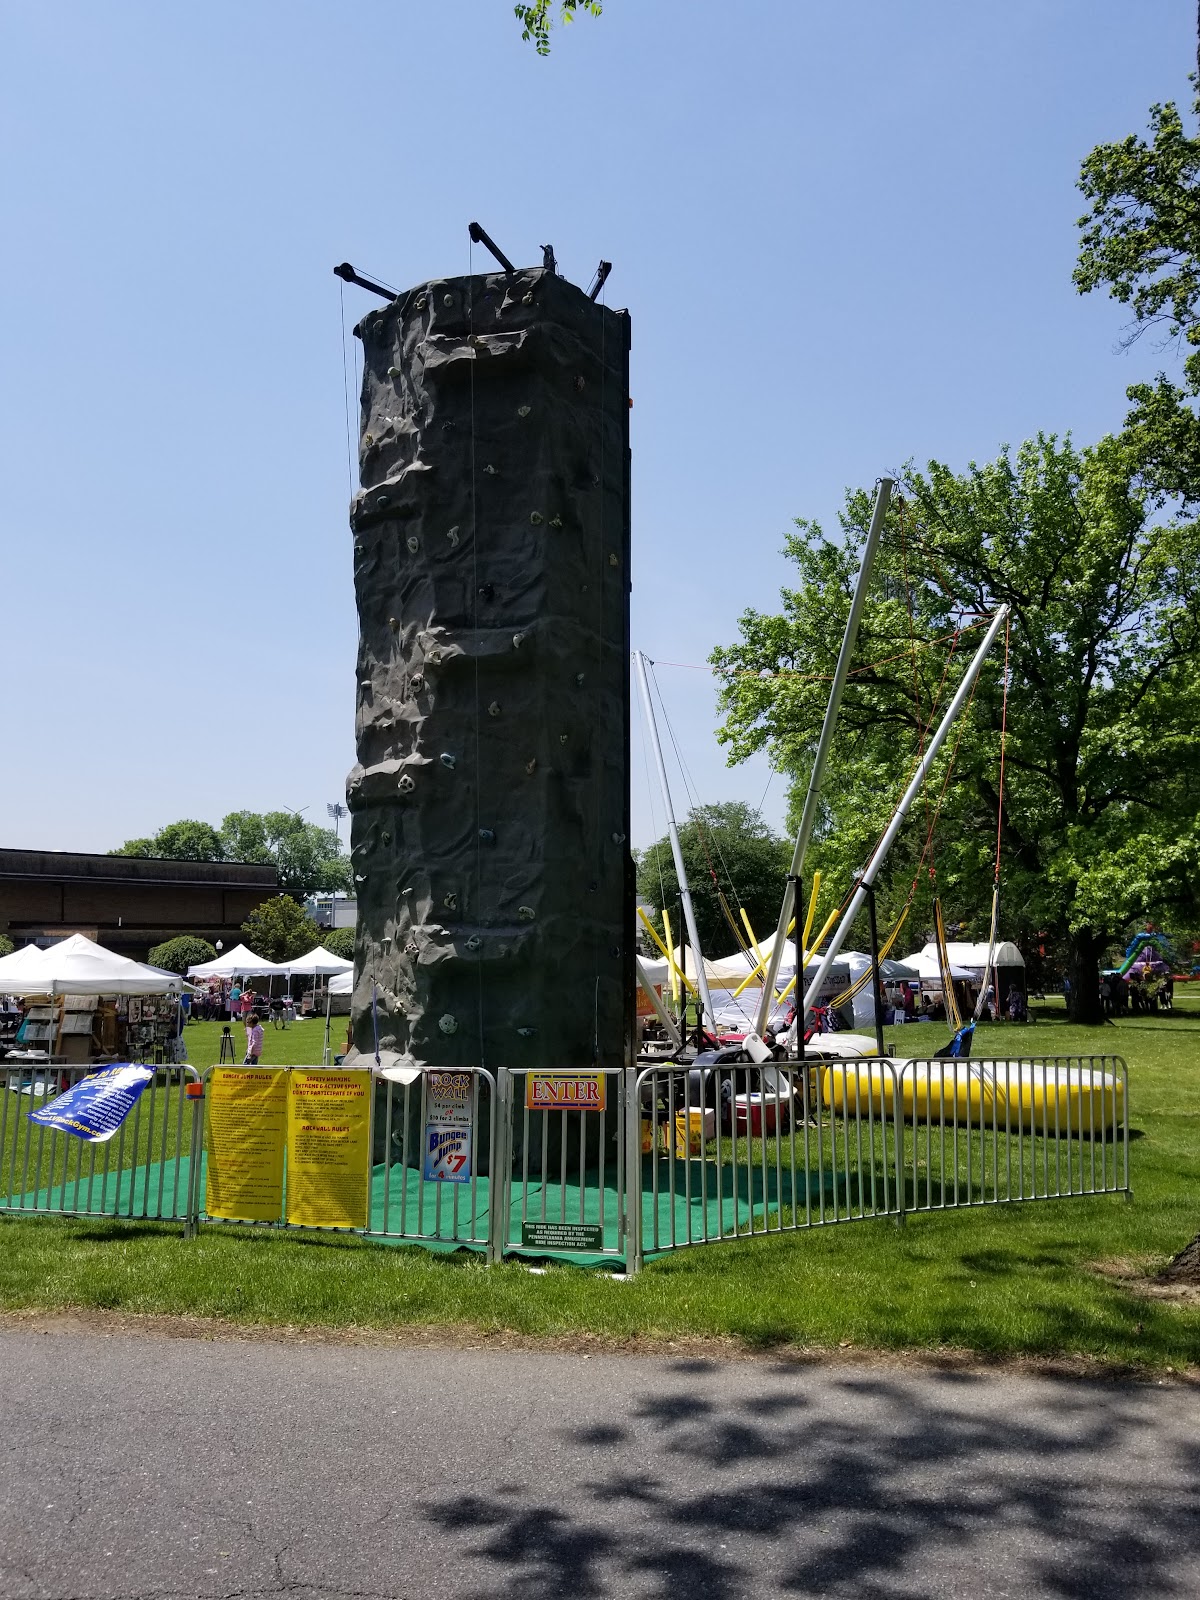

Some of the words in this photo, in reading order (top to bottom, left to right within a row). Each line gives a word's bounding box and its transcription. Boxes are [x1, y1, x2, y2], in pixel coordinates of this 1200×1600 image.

[432, 1073, 470, 1088] ROCK
[431, 1086, 468, 1101] WALL
[532, 1081, 600, 1100] ENTER
[430, 1130, 468, 1154] Bungee
[433, 1142, 462, 1168] Jump
